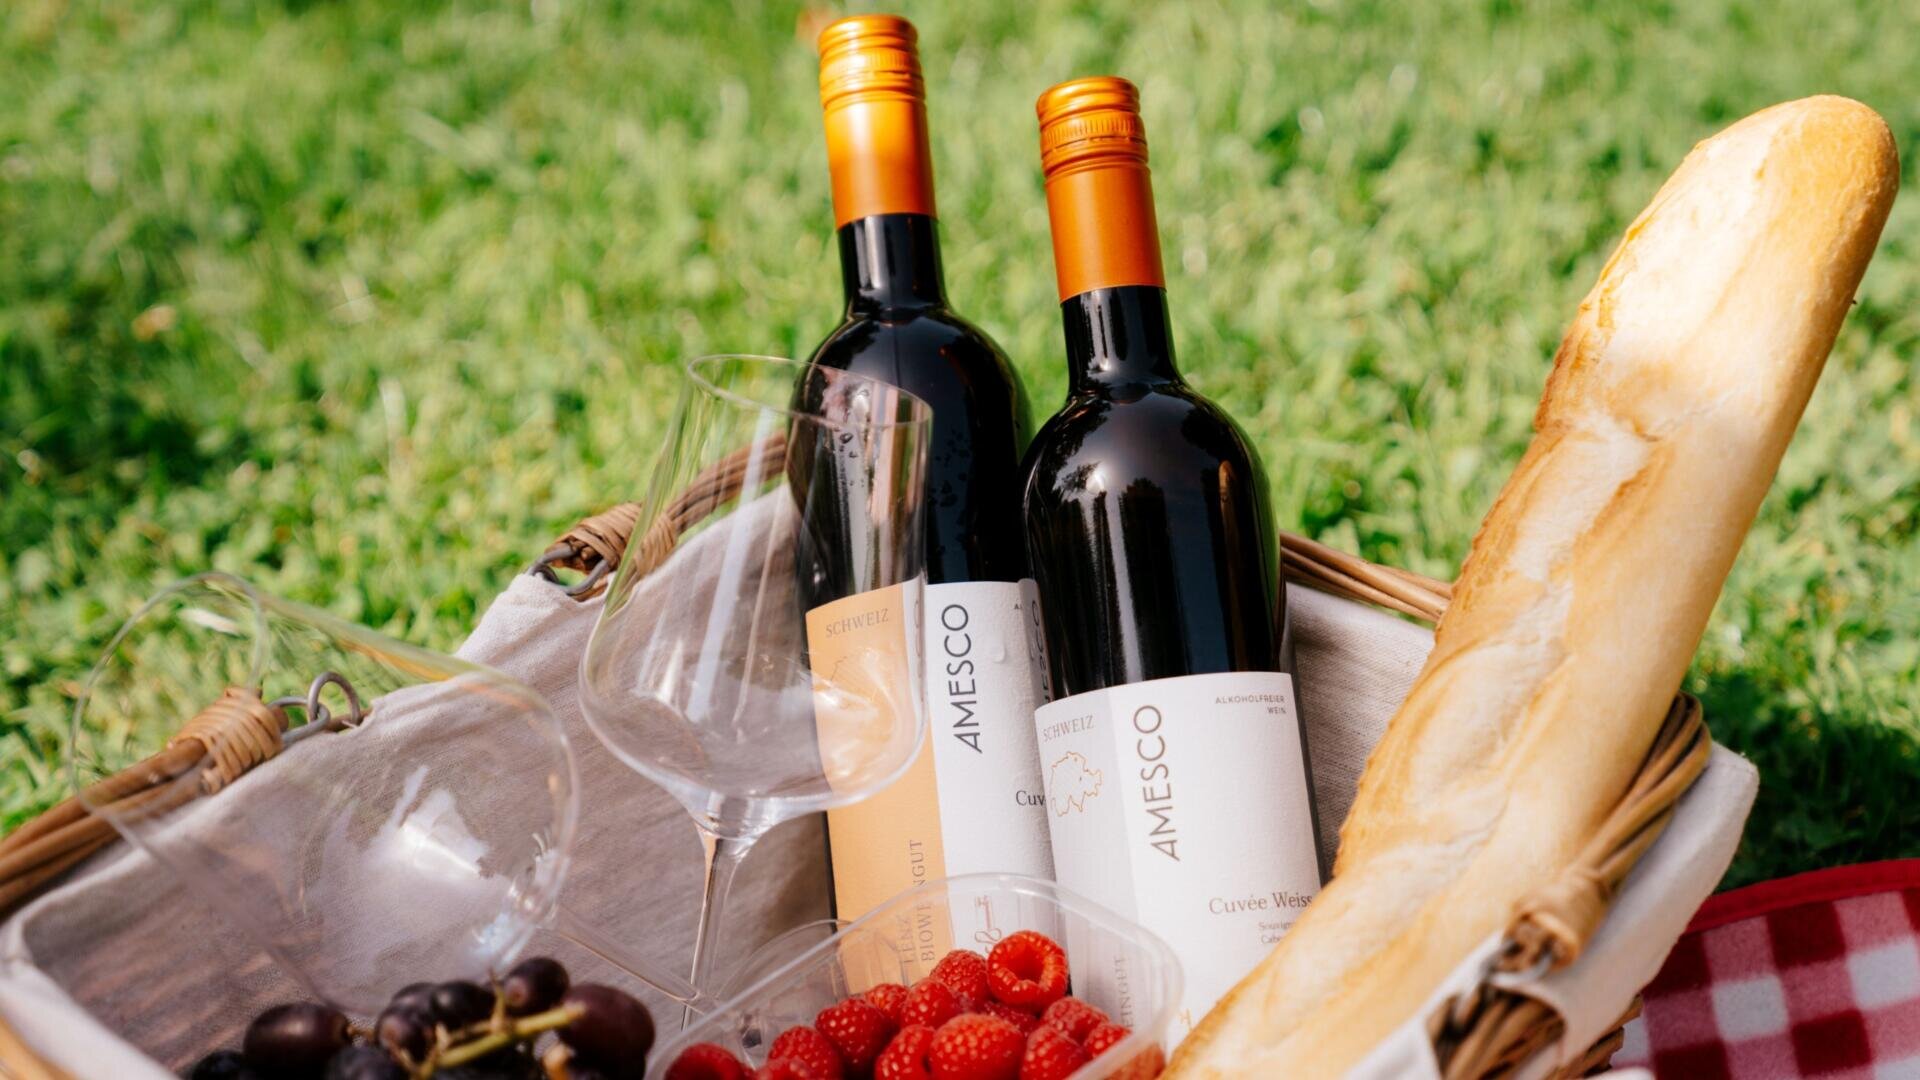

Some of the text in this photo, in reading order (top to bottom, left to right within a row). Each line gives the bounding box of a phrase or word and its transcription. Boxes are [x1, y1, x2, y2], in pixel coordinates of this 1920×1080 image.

[825, 608, 889, 638] SCHWEIZ
[941, 603, 983, 754] AMESCO
[1215, 694, 1285, 704] ALKOHOLFREIER
[1267, 706, 1287, 714] WEIN
[1043, 714, 1094, 742] SCHWEIZ
[1133, 705, 1180, 861] AMESCO
[1015, 790, 1046, 806] Cuv
[1209, 894, 1268, 915] Cuvée
